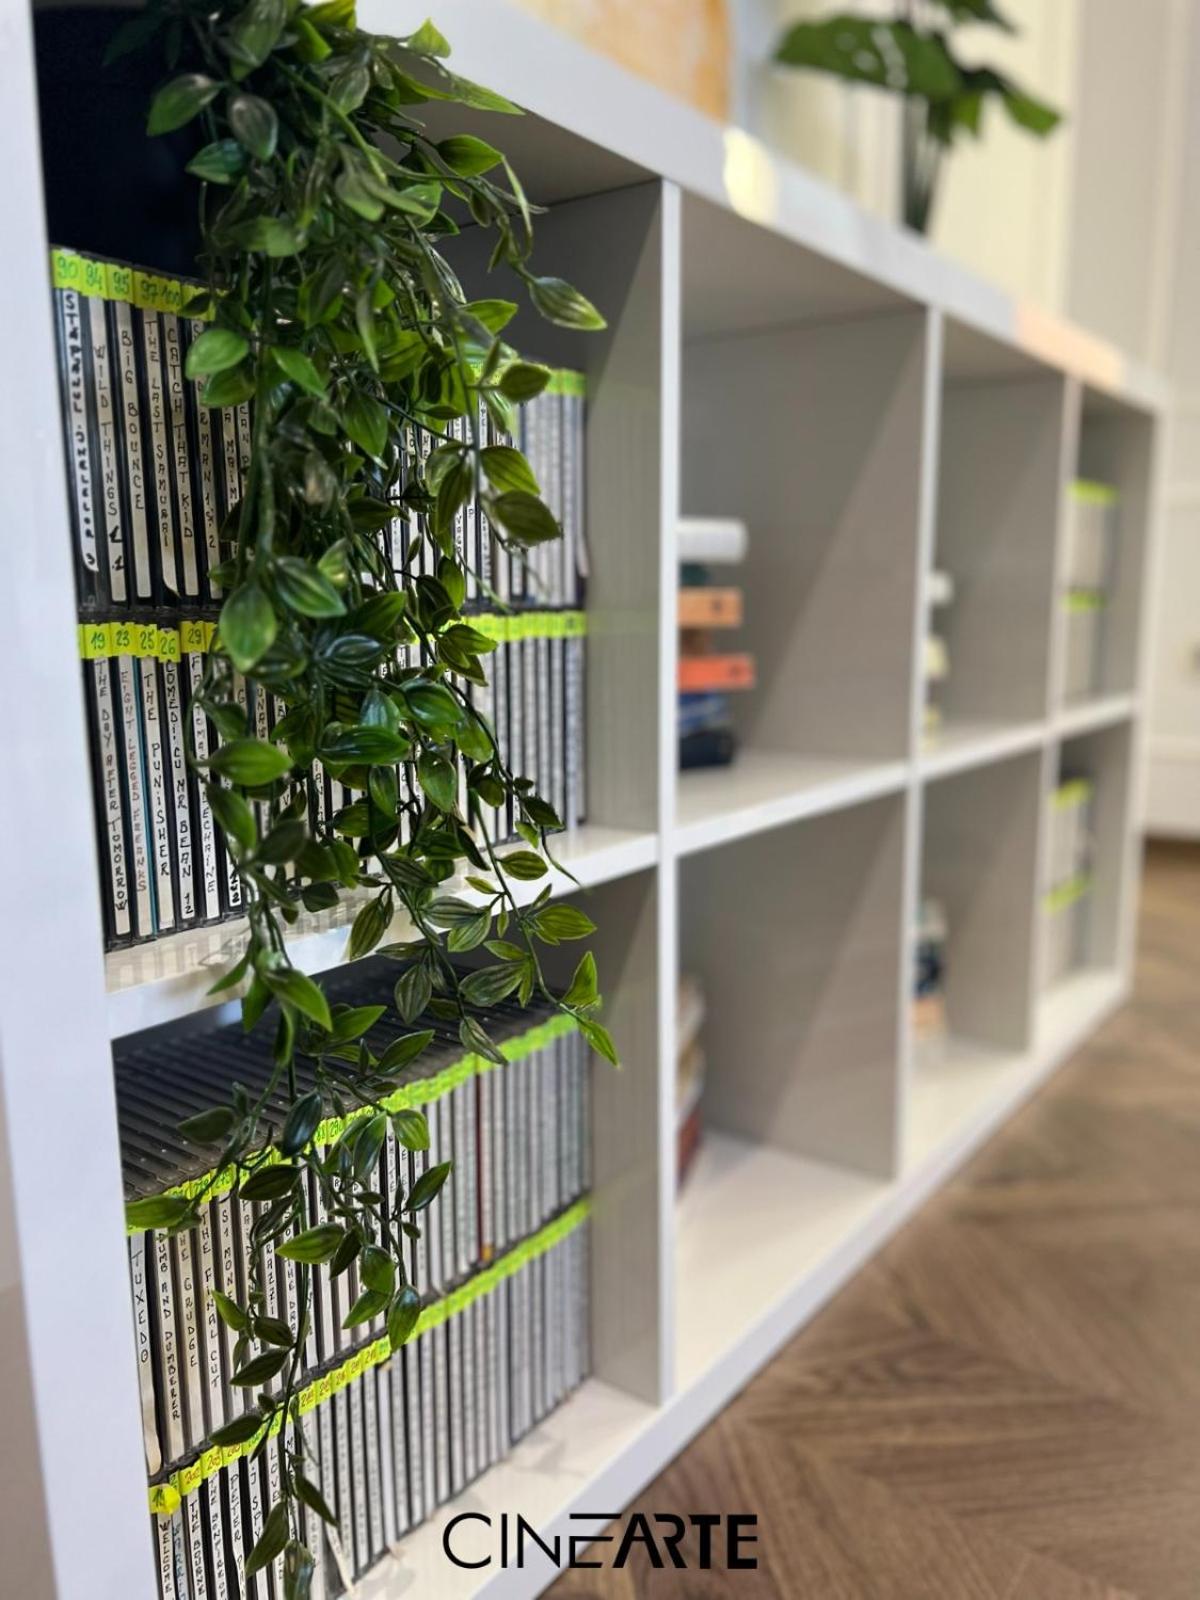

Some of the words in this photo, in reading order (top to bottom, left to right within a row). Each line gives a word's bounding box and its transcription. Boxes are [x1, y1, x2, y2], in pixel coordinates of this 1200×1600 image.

[121, 330, 134, 384] BIG
[145, 320, 159, 362] THE
[167, 328, 184, 413] CATCH
[93, 345, 109, 409] WILD
[101, 422, 118, 516] THINGS
[152, 379, 164, 432] LAST
[126, 402, 144, 510] BOUNCE
[174, 424, 189, 484] THAT
[156, 444, 171, 548] SAMURAI
[181, 494, 194, 538] KID
[91, 631, 105, 649] 19
[116, 630, 130, 646] 23
[139, 630, 155, 650] 25
[160, 637, 176, 655] 26
[188, 628, 201, 644] 29
[95, 661, 109, 697] THE
[120, 671, 135, 729] EIGHT
[102, 709, 112, 749] DAY
[105, 754, 119, 810] AFTER
[127, 739, 140, 801] LEGGED
[144, 674, 157, 720] THE
[152, 744, 170, 876] PUNISHER
[174, 748, 182, 768] CU
[179, 821, 192, 879] BEAN
[107, 816, 128, 912] TOMORROW
[201, 1211, 211, 1254] THE
[156, 1233, 168, 1272] DUMB
[162, 1284, 172, 1318] AND
[131, 1252, 149, 1363] TUXEDO
[184, 1278, 197, 1368] GRUDGE
[205, 1269, 220, 1339] FINAL
[210, 1351, 220, 1387] CUT
[209, 1473, 218, 1506] THE
[270, 1447, 281, 1503] LOVE
[189, 1502, 200, 1533] THE
[230, 1473, 242, 1543] PETER
[160, 1520, 173, 1593] WELCOME
